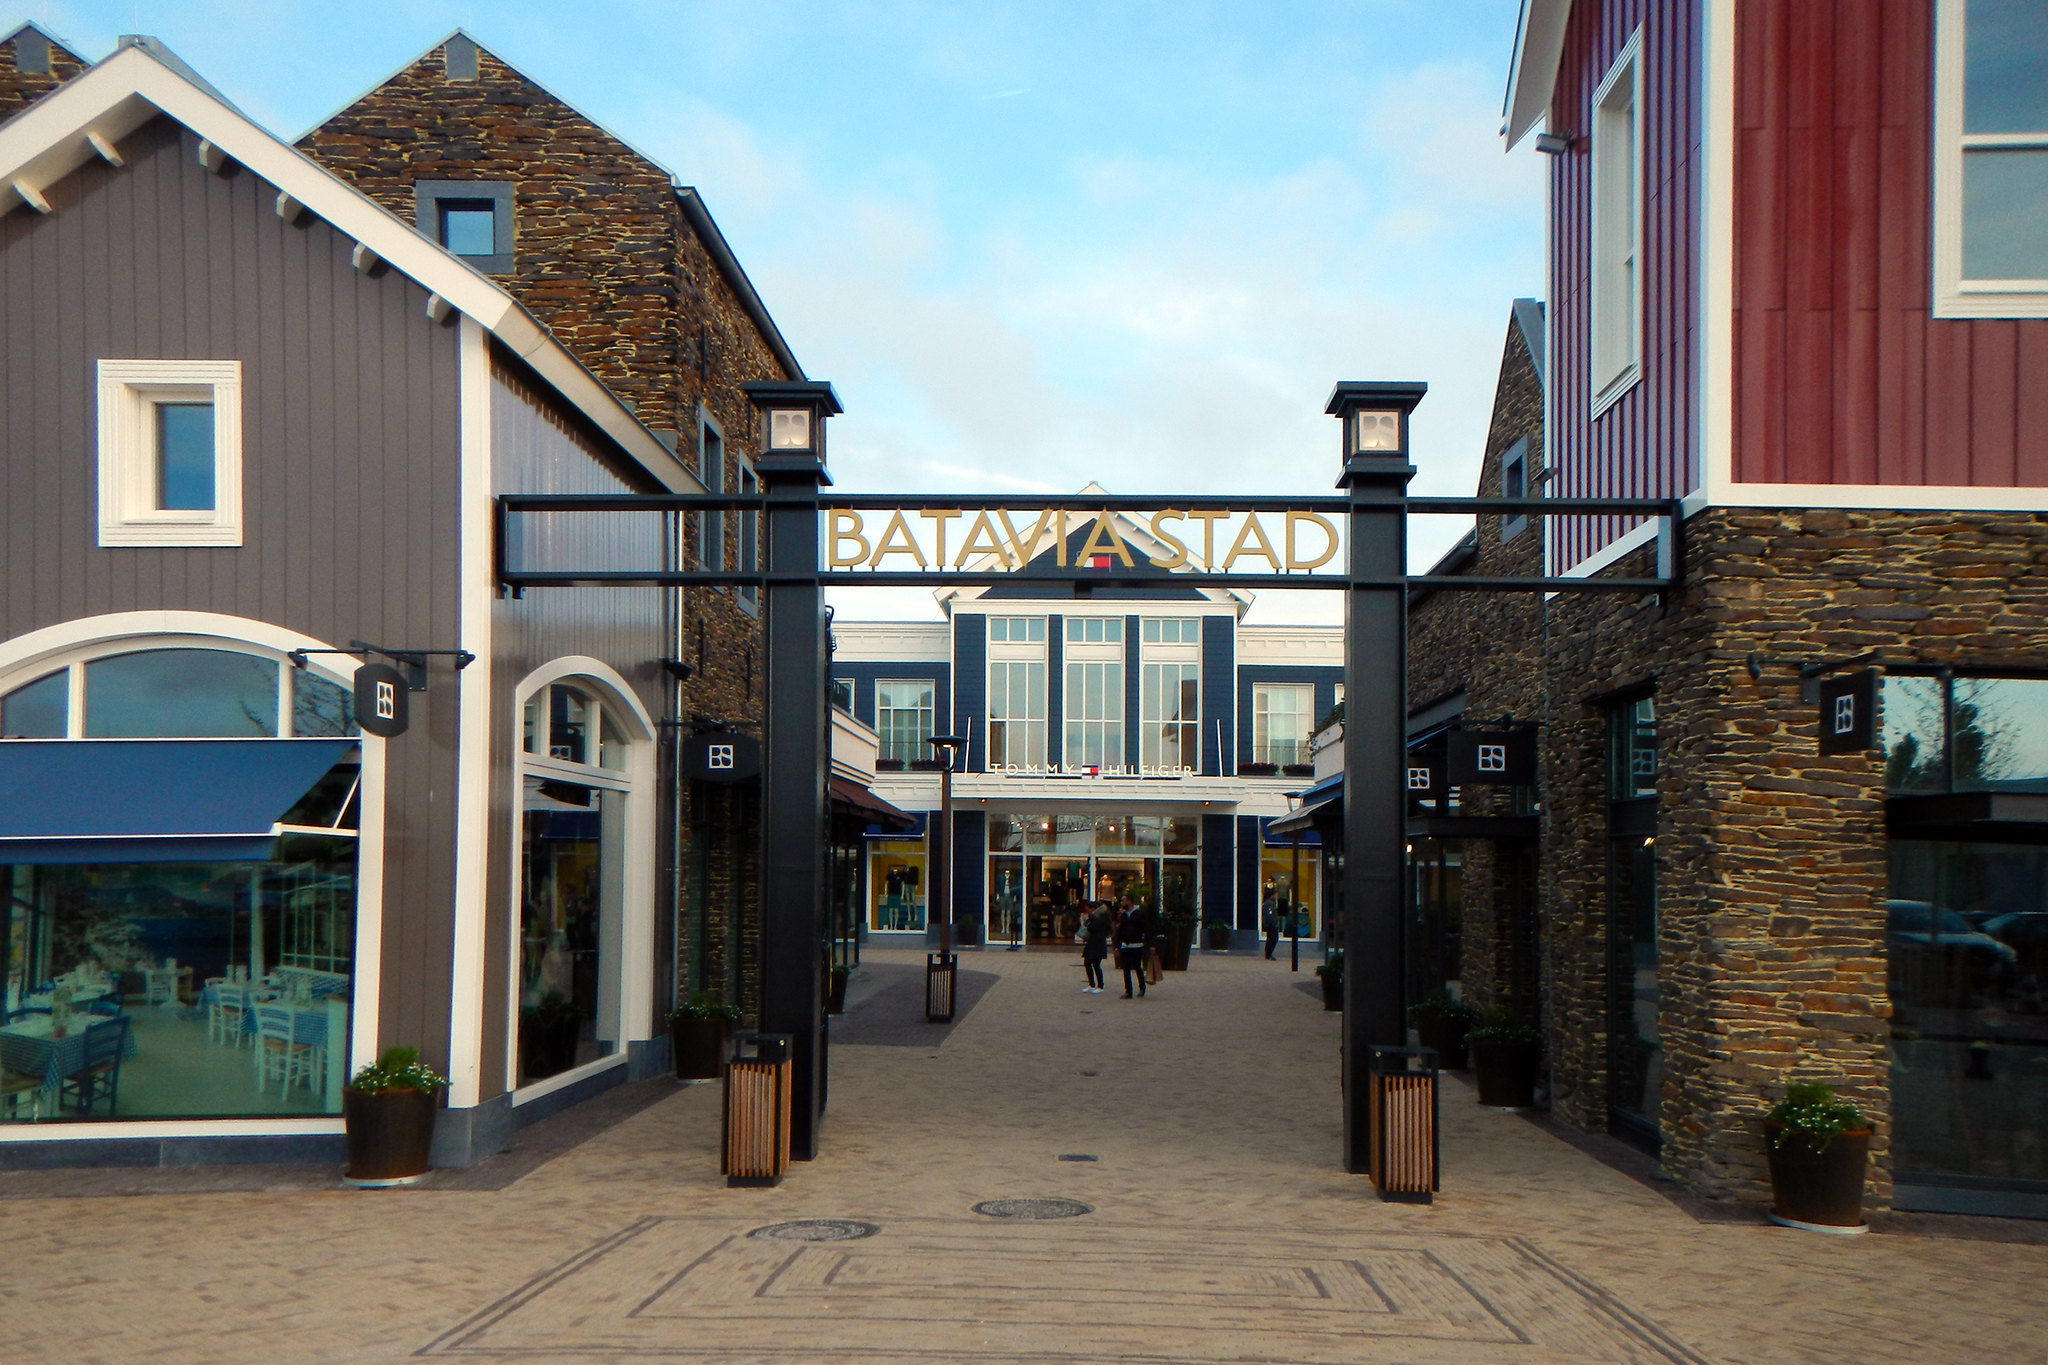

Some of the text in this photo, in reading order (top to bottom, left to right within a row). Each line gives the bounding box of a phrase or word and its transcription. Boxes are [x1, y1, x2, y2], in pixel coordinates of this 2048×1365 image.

[829, 508, 1339, 570] BATAVIA STAD
[991, 763, 1193, 777] TOMMY HILFIGER
